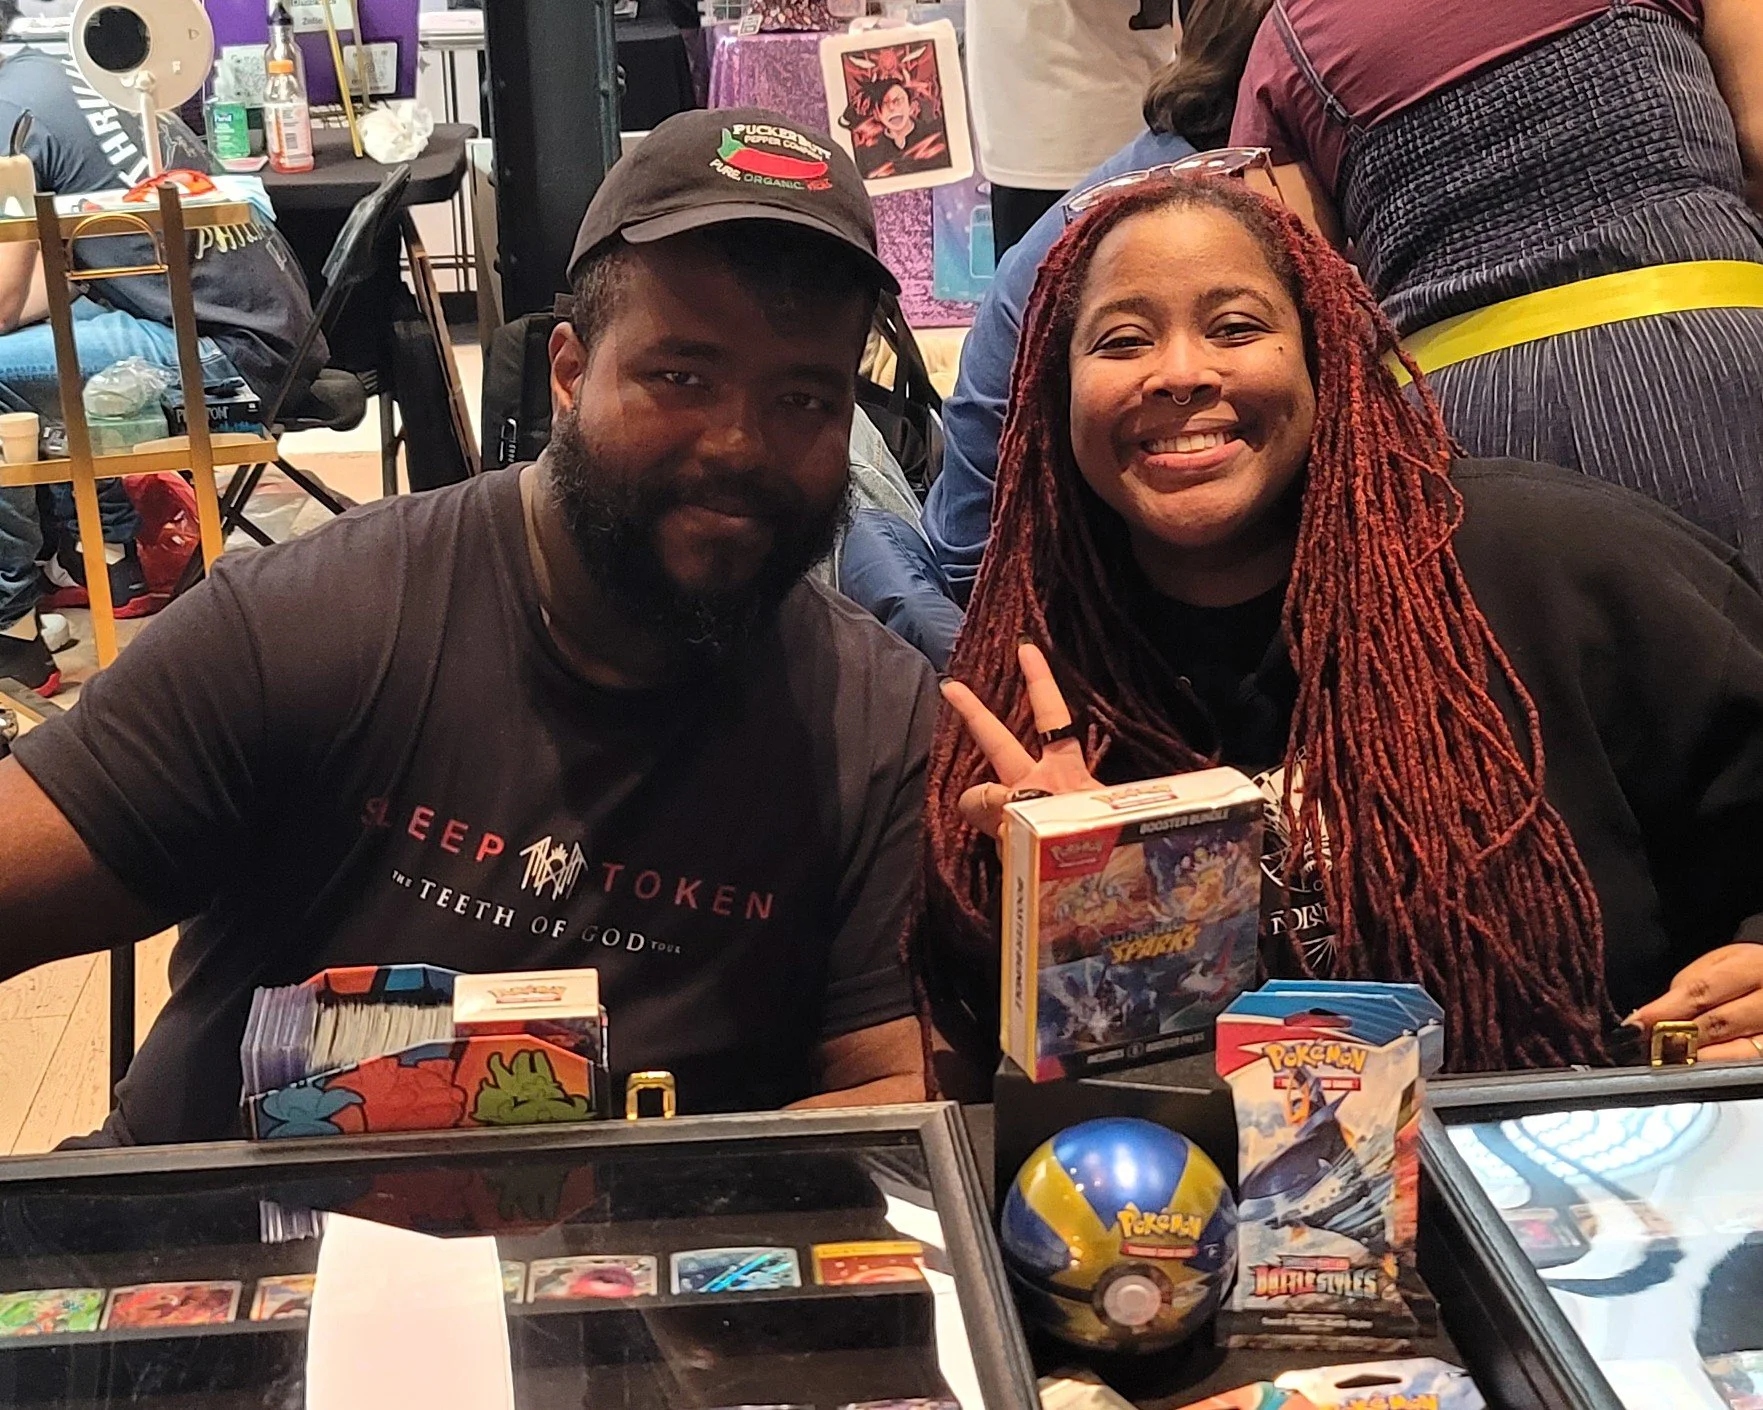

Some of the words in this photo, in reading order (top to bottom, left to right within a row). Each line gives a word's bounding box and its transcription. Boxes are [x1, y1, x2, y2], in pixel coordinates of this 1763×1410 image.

[732, 124, 832, 160] PUCKERBUTT
[744, 134, 782, 146] PEPPER
[782, 139, 824, 161] COMPANY
[602, 862, 774, 920] TOKEN
[391, 868, 414, 889] THE
[418, 878, 516, 929] TEETH
[530, 915, 568, 939] OF
[581, 925, 646, 953] GOD
[651, 940, 681, 955] TOUR
[1316, 1267, 1379, 1300] STYLES
